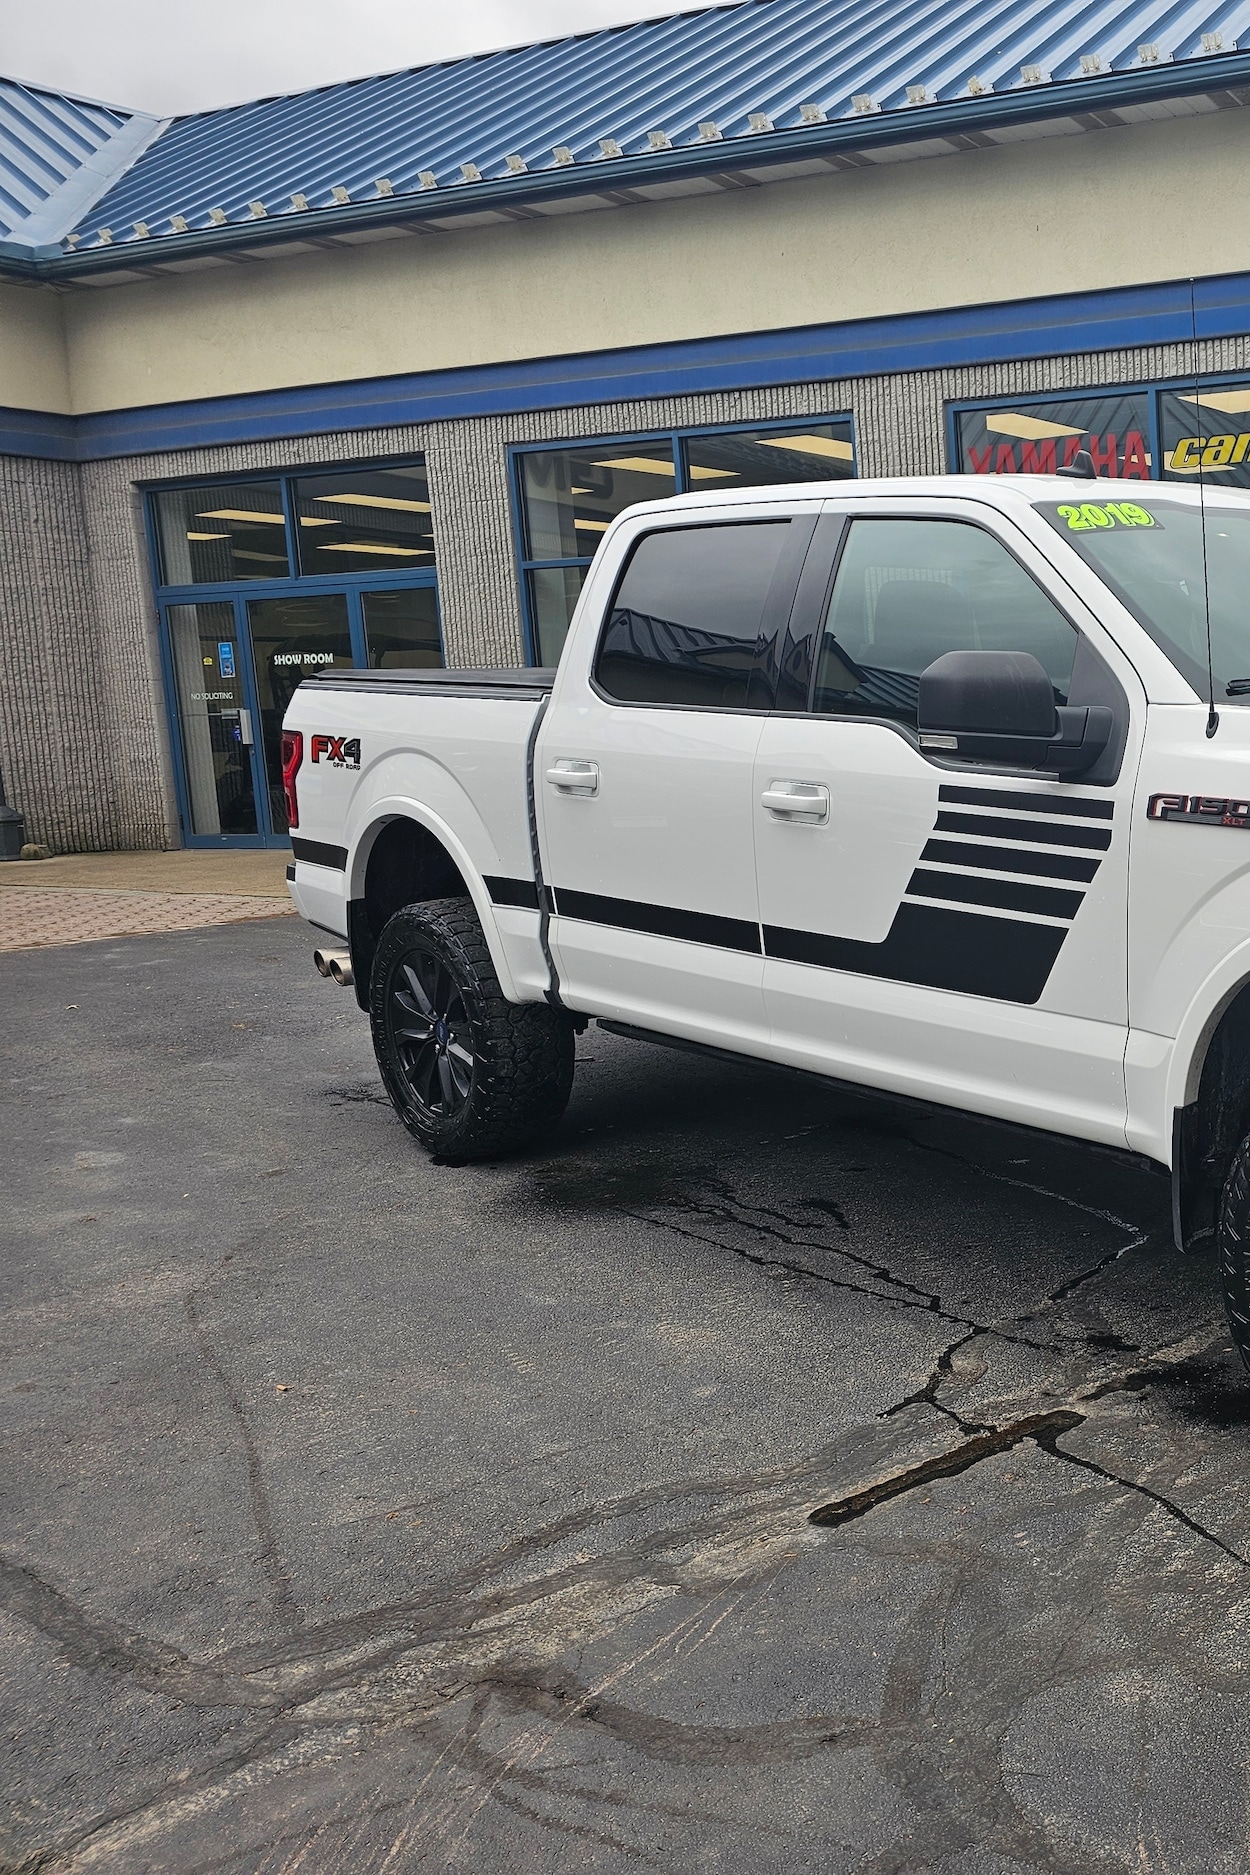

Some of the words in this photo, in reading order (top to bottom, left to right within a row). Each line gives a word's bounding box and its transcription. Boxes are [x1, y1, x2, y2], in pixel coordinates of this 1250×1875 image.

[1056, 502, 1155, 531] 2019
[273, 654, 302, 665] SHOW
[304, 653, 334, 665] ROOM
[190, 692, 201, 700] NO
[201, 691, 234, 700] SOLICITING
[311, 734, 361, 764] FX4
[1222, 816, 1247, 826] XLT
